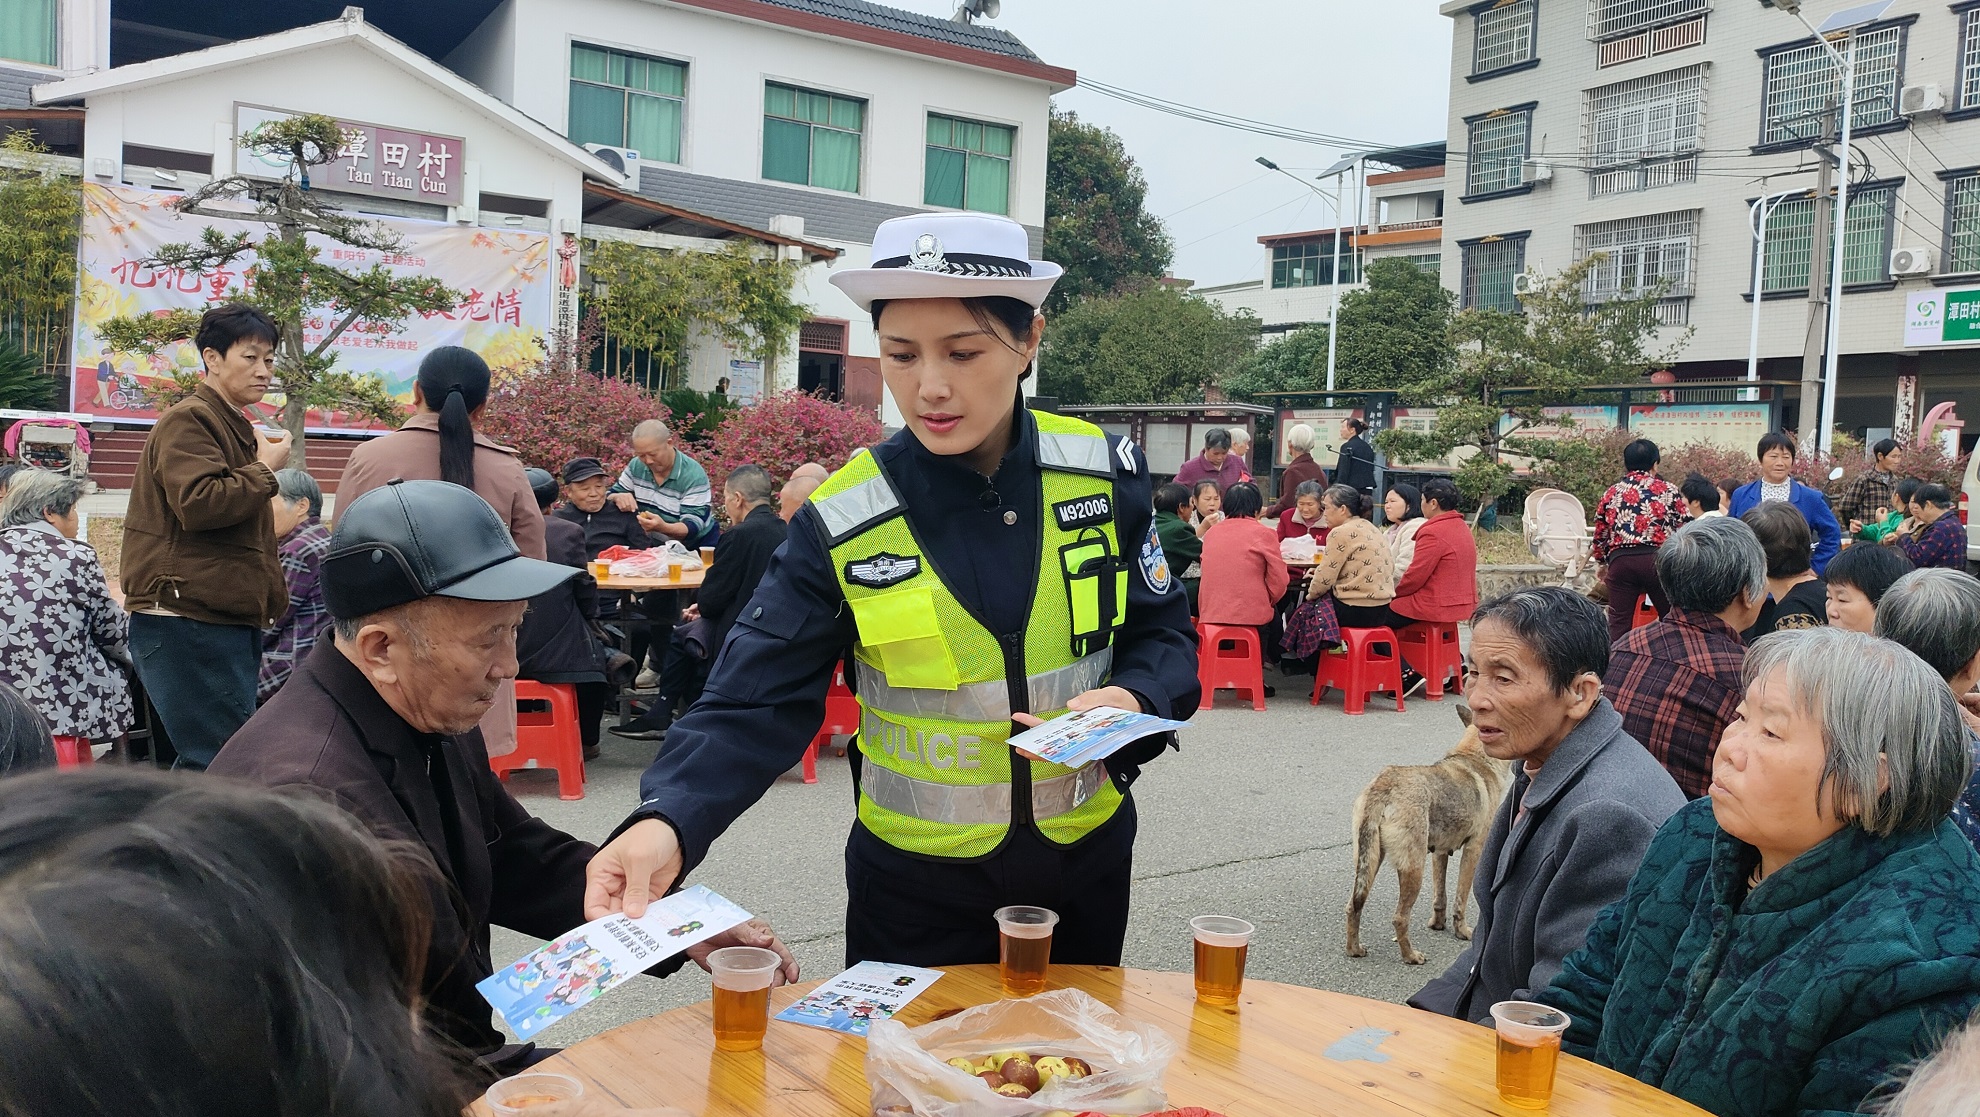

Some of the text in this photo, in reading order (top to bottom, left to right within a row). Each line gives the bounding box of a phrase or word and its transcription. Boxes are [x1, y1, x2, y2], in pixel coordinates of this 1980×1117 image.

[337, 127, 452, 179] 潭田村
[346, 166, 447, 194] Tan Tian Cun
[1059, 498, 1109, 522] M92006
[864, 712, 981, 769] POLICE
